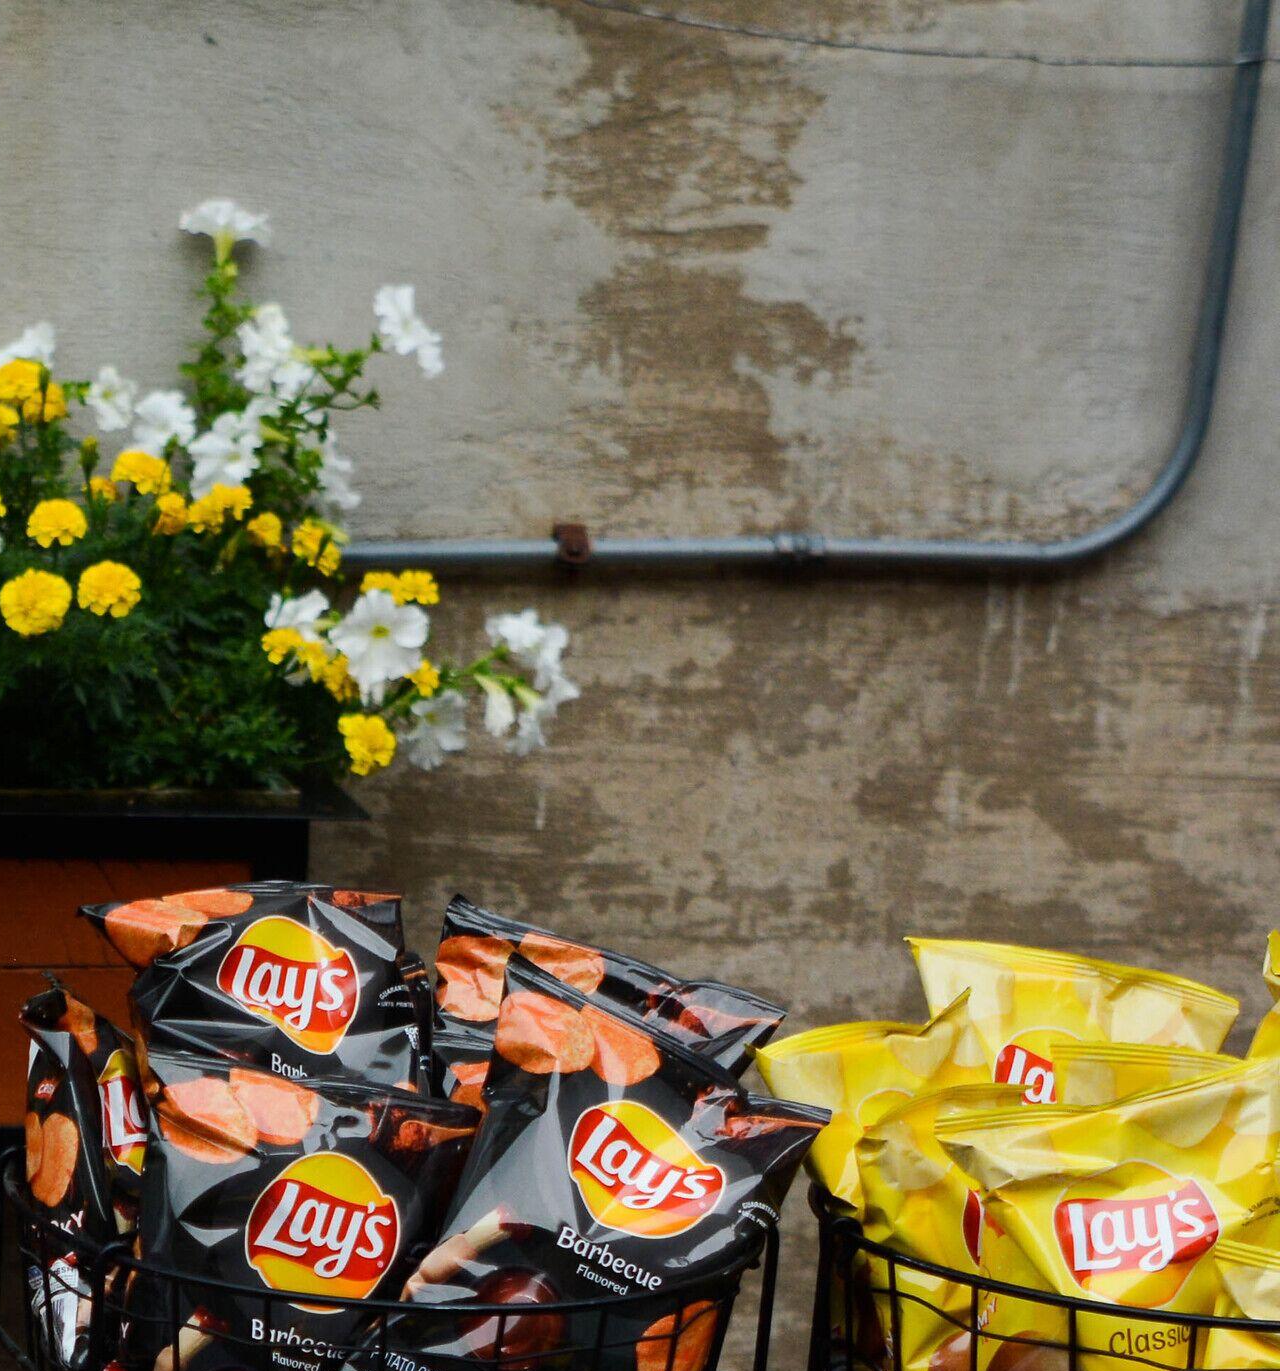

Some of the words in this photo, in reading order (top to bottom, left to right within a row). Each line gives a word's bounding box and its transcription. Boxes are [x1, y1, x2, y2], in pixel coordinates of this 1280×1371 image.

[232, 947, 348, 1031] Lay's
[575, 1114, 715, 1210] Lay's
[253, 1181, 391, 1278] Lay's
[556, 1226, 663, 1291] Barbecue
[1067, 1190, 1206, 1272] Lay's
[575, 1265, 630, 1296] Flavored
[1109, 1323, 1194, 1356] Classic
